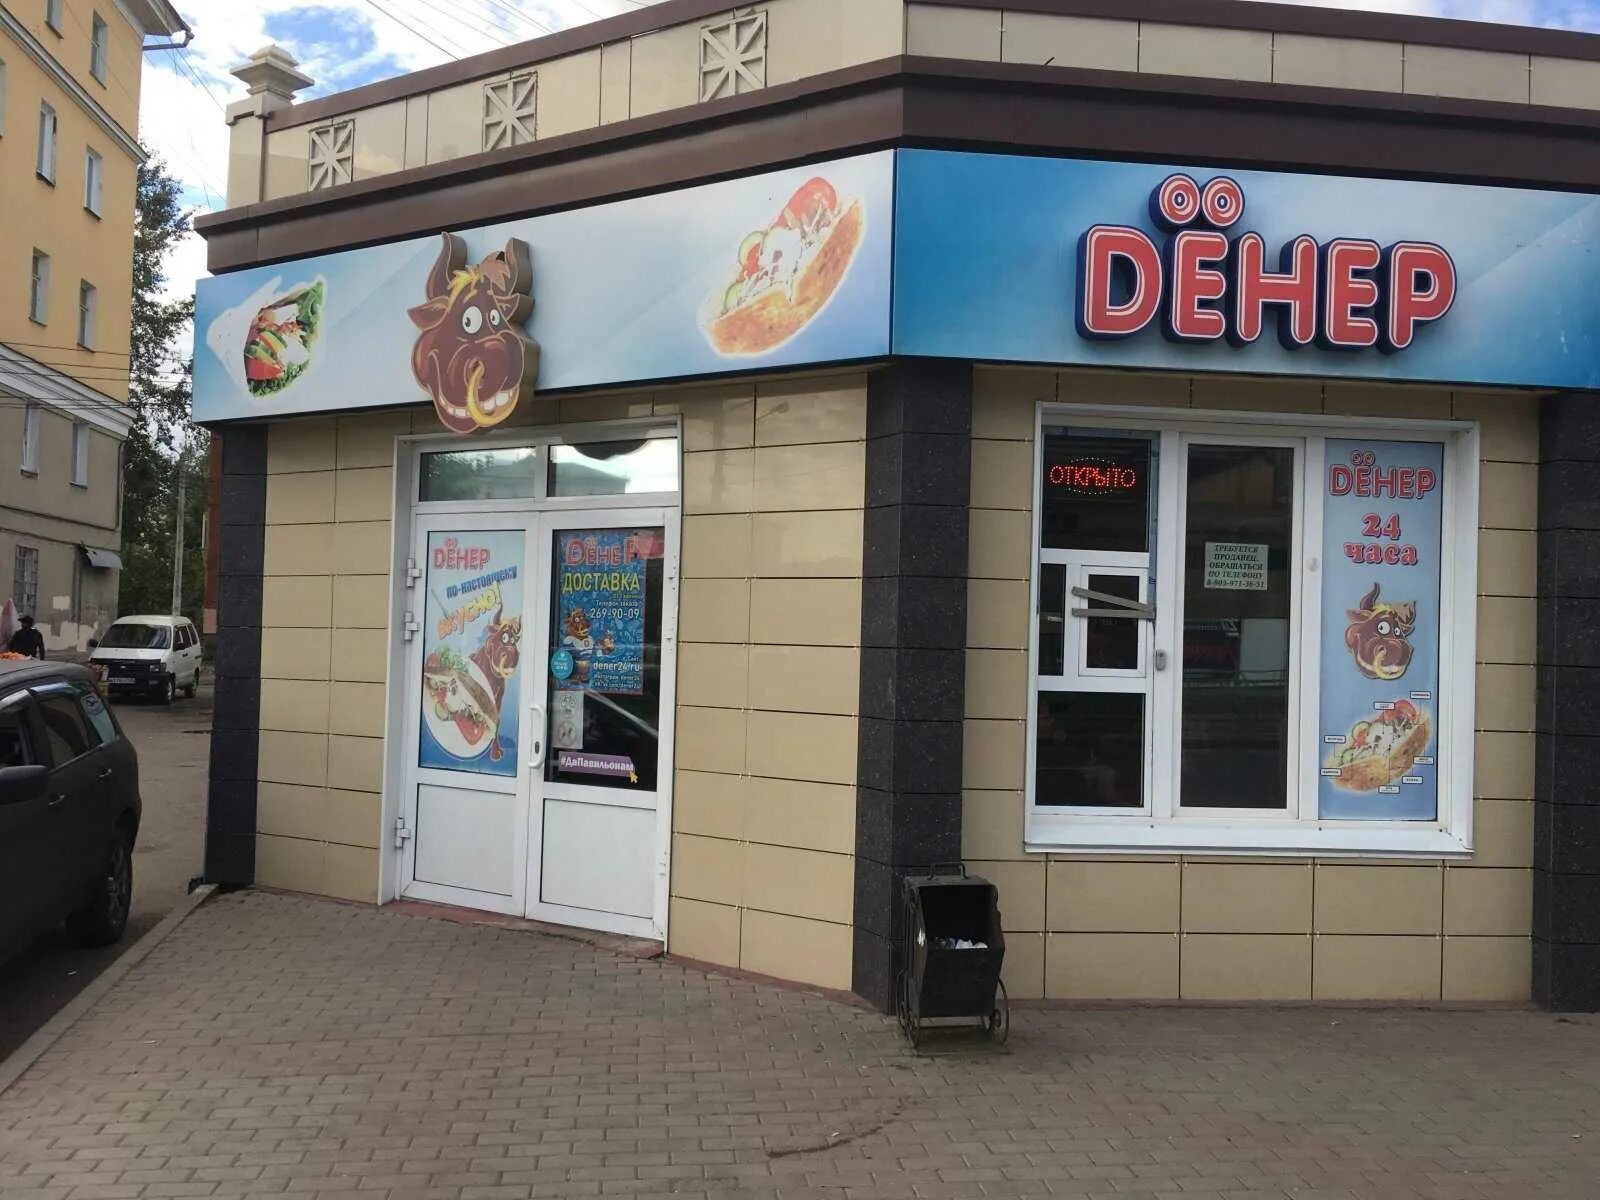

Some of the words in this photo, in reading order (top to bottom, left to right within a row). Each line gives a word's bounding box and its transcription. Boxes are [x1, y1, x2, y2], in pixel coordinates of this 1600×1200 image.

[1050, 466, 1136, 488] ОТКРЫТО
[1361, 513, 1401, 540] 24
[1344, 543, 1418, 565] часа
[562, 572, 640, 595] ДОСТАВКА
[590, 608, 640, 619] 269-90-09
[560, 755, 634, 771] #ДаПавильонам
